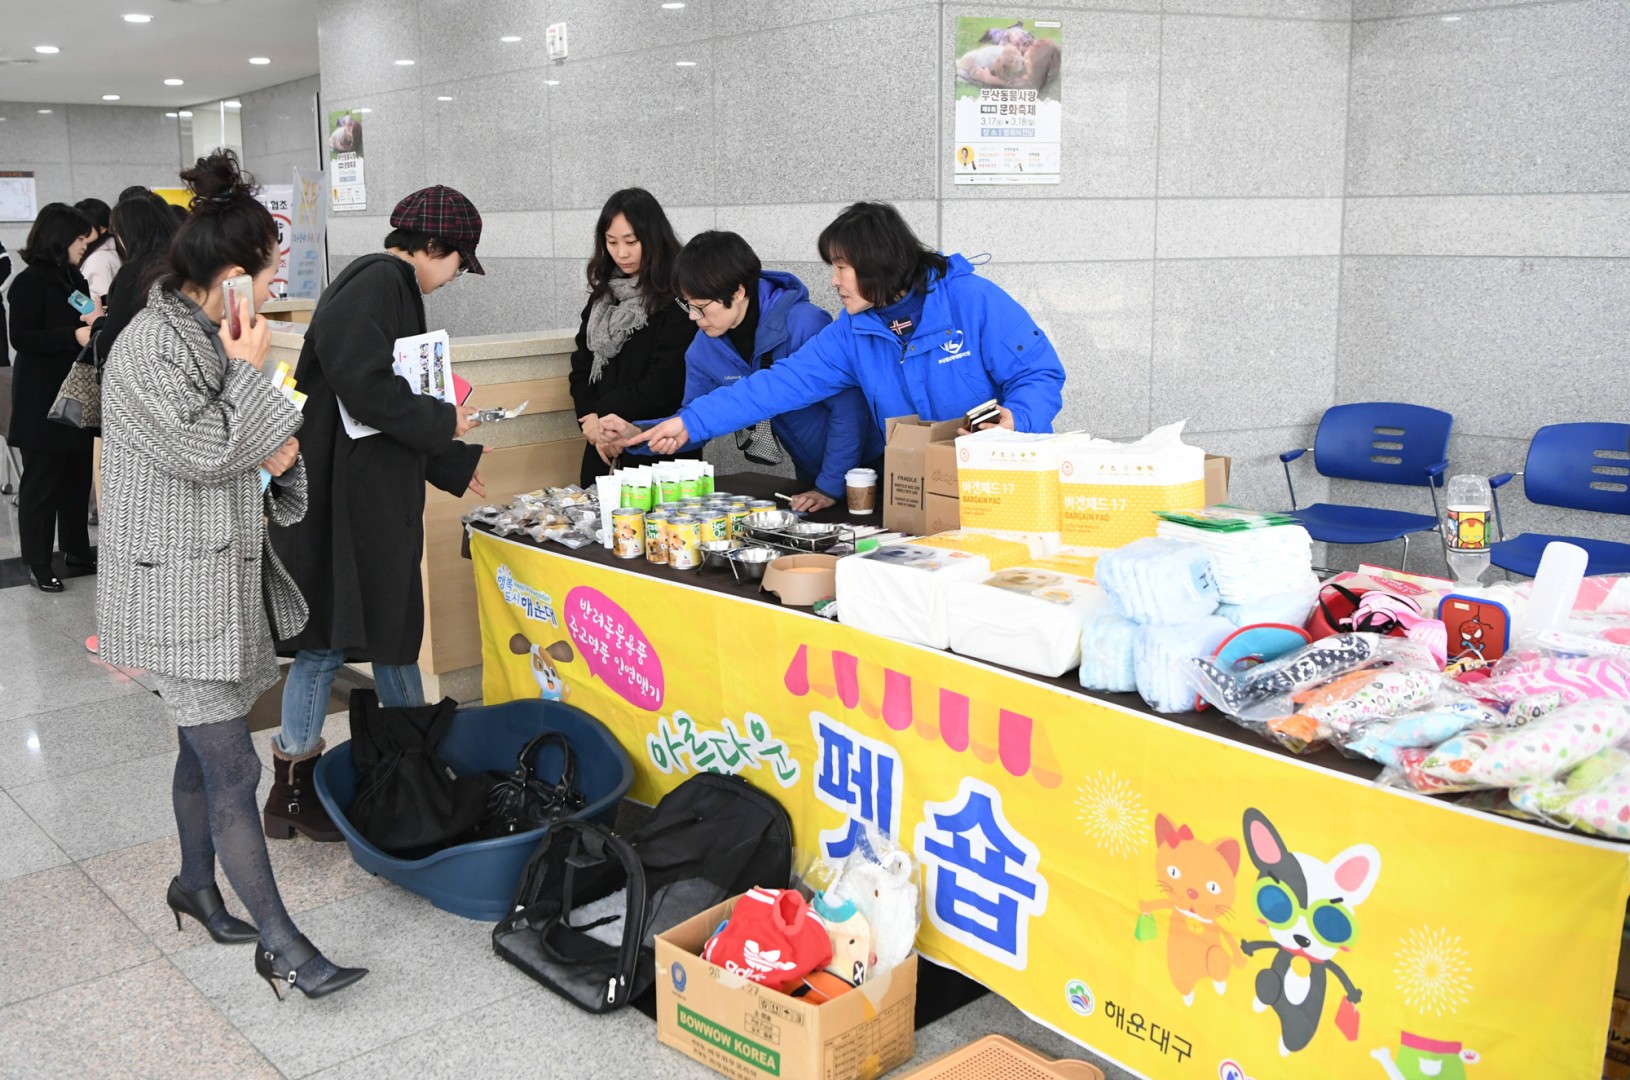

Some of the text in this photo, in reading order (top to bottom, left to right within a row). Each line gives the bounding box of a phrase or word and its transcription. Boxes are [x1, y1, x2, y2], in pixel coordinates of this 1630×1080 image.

[981, 89, 1037, 102] 부산동물사랑
[999, 104, 1036, 116] 문화축제
[270, 200, 288, 210] 협조
[897, 475, 917, 483] FRAGILE
[962, 496, 1001, 505] BARGAIN PAD
[1064, 512, 1110, 521] BARGAIN PAD
[713, 529, 726, 539] On
[521, 597, 557, 626] 해운대
[579, 597, 648, 665] 반려동물용품
[614, 656, 661, 703] 인연맺기
[650, 716, 797, 781] 아름다운
[1105, 1000, 1193, 1063] 해운대구
[679, 1010, 732, 1048] BOWWOW
[734, 1039, 777, 1070] KOREA
